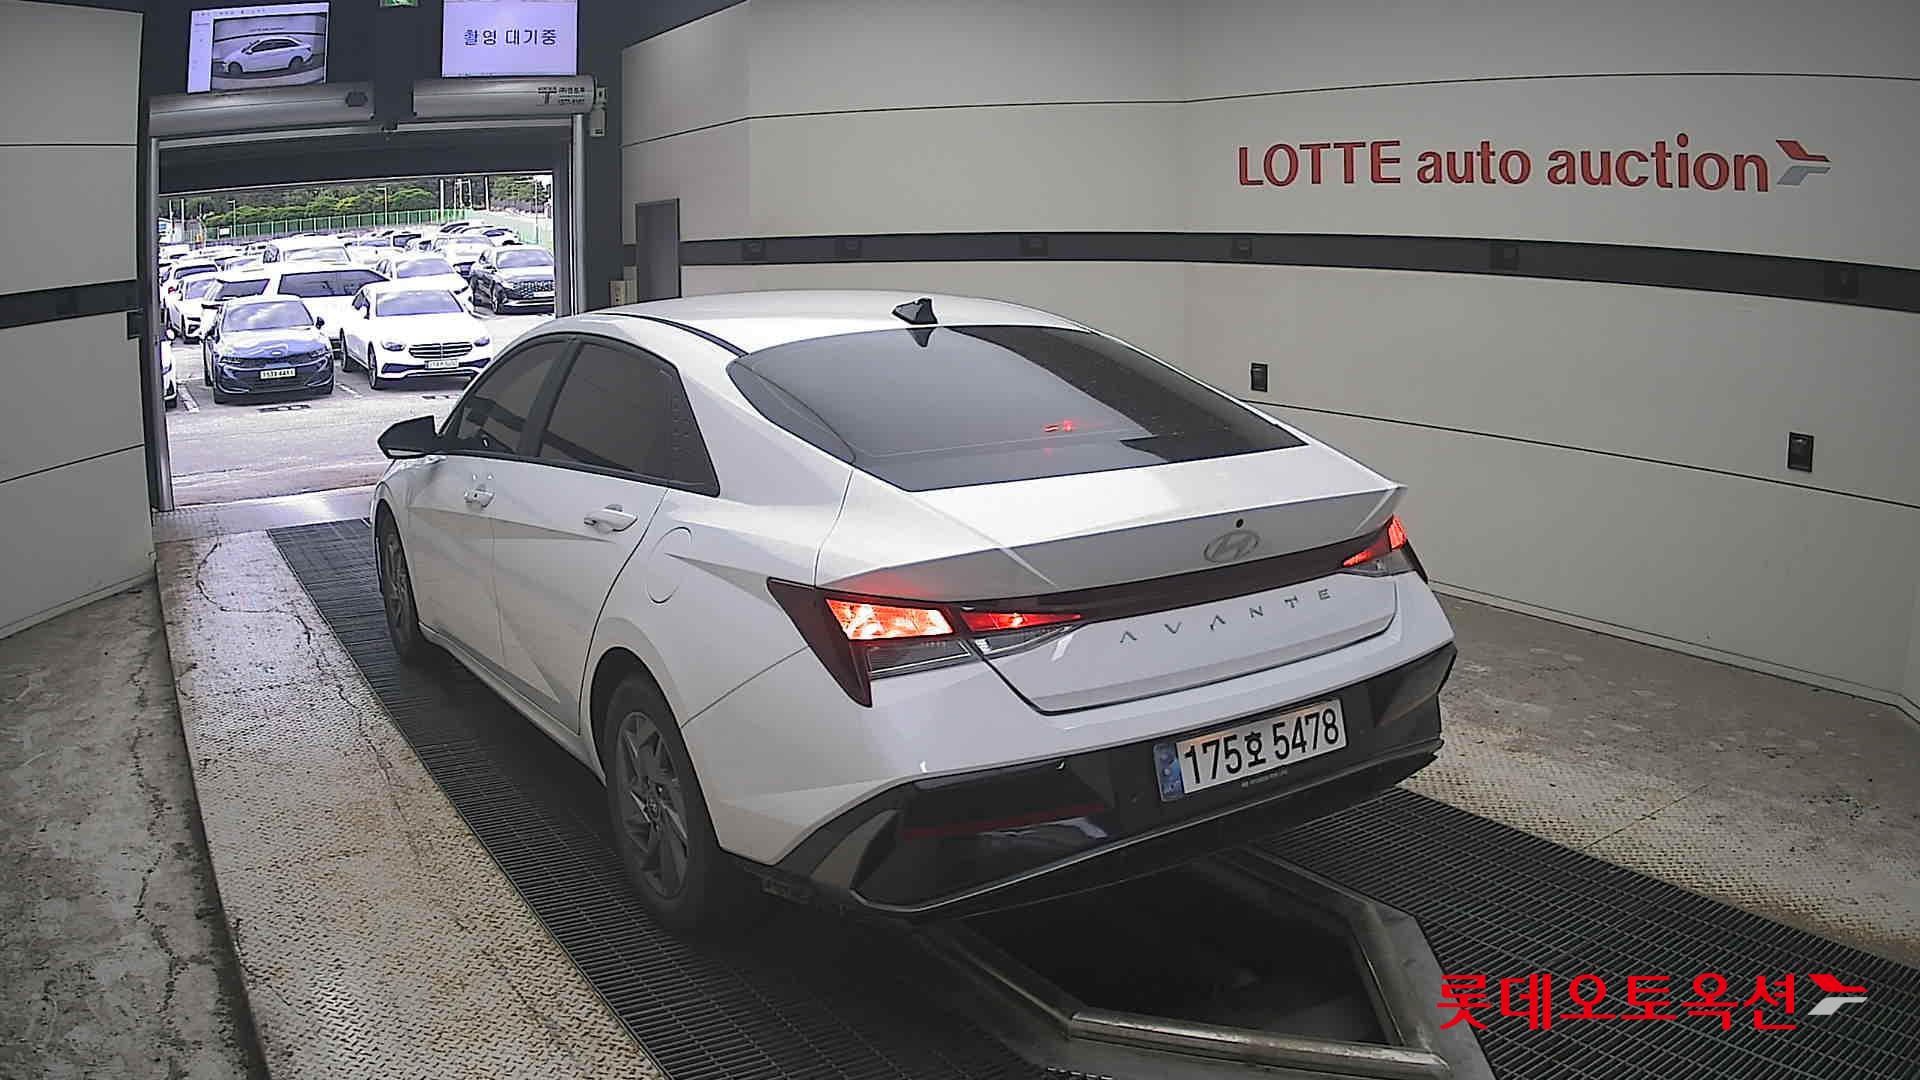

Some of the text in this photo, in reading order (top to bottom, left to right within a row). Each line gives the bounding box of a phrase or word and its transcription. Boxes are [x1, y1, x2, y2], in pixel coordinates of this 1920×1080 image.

[505, 29, 558, 46] 대기중
[1238, 133, 1769, 192] LOTTE auto auction
[1119, 588, 1331, 644] AVANTE
[1184, 708, 1339, 785] 175호 5478
